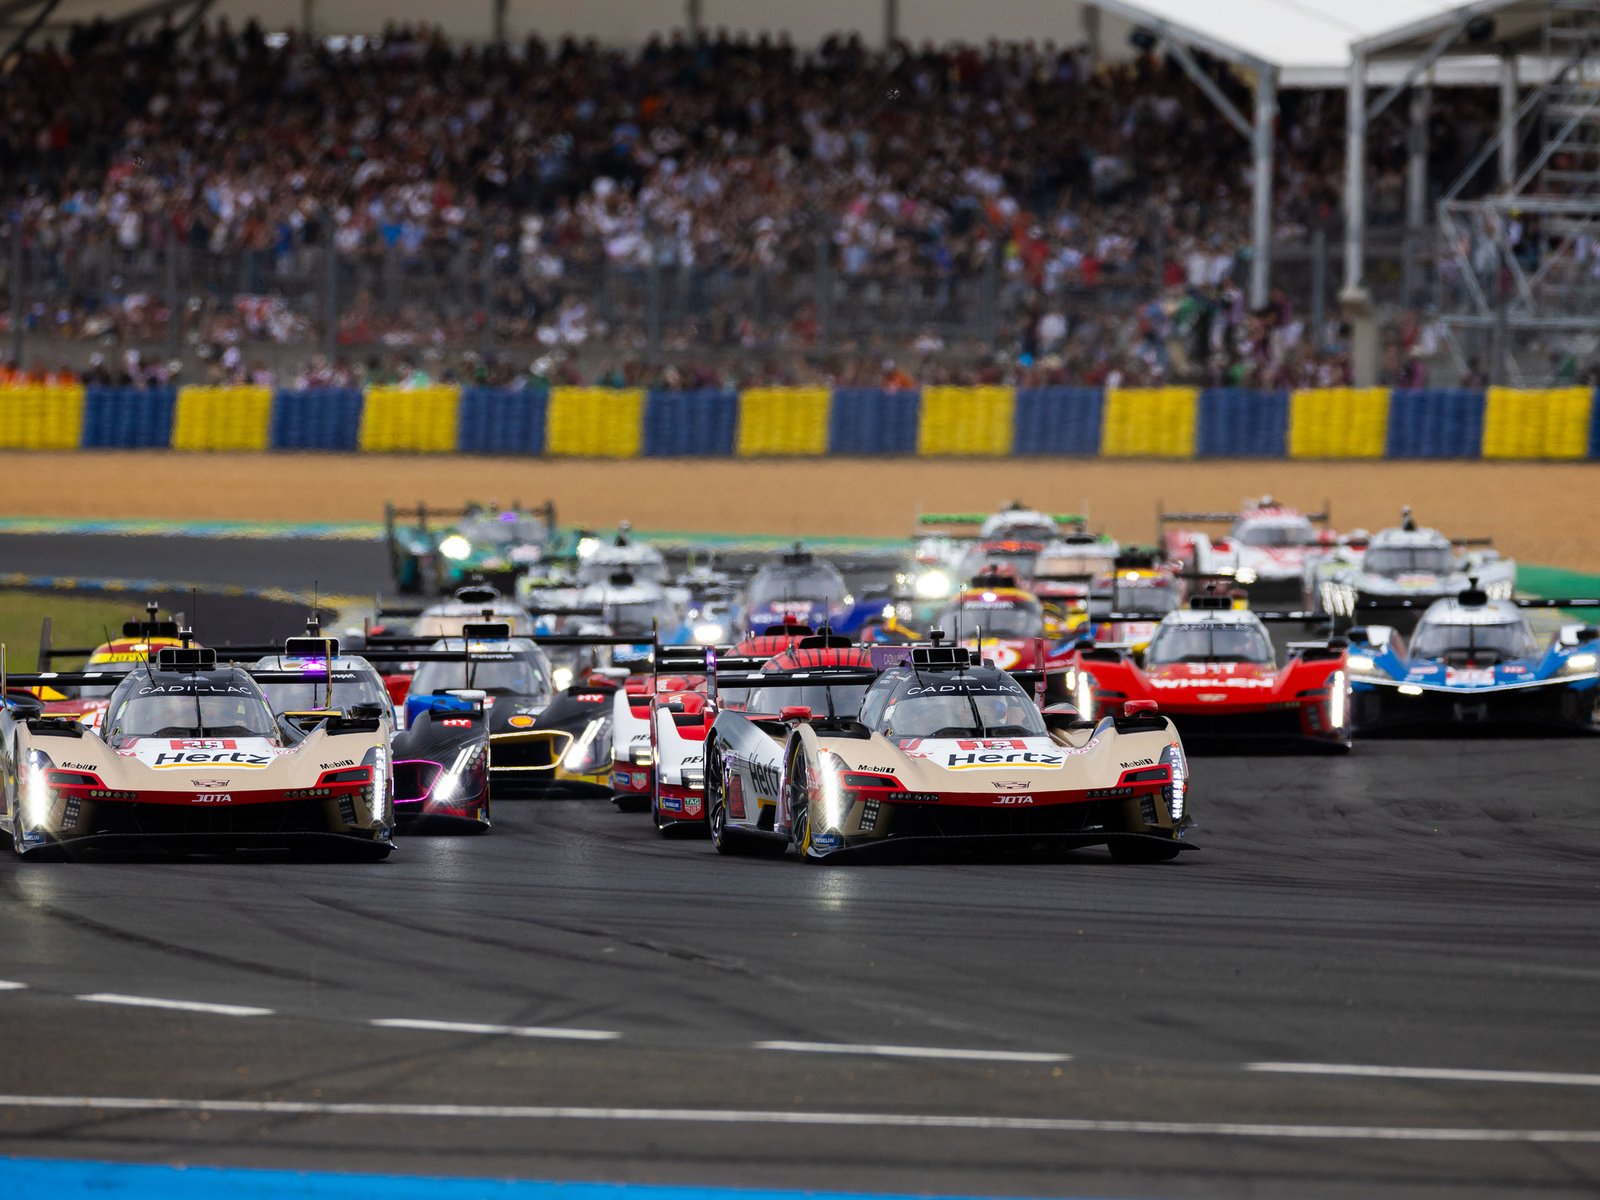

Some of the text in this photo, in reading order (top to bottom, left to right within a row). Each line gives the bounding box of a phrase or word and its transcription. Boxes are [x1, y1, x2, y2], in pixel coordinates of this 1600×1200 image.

[1150, 678, 1274, 688] WHELEN
[139, 685, 252, 695] CADILLAC
[907, 685, 1022, 695] CADILLAC
[154, 752, 271, 765] Hertz
[947, 752, 1063, 766] Hertz
[191, 794, 232, 803] JOTA
[992, 795, 1034, 804] JOTA
